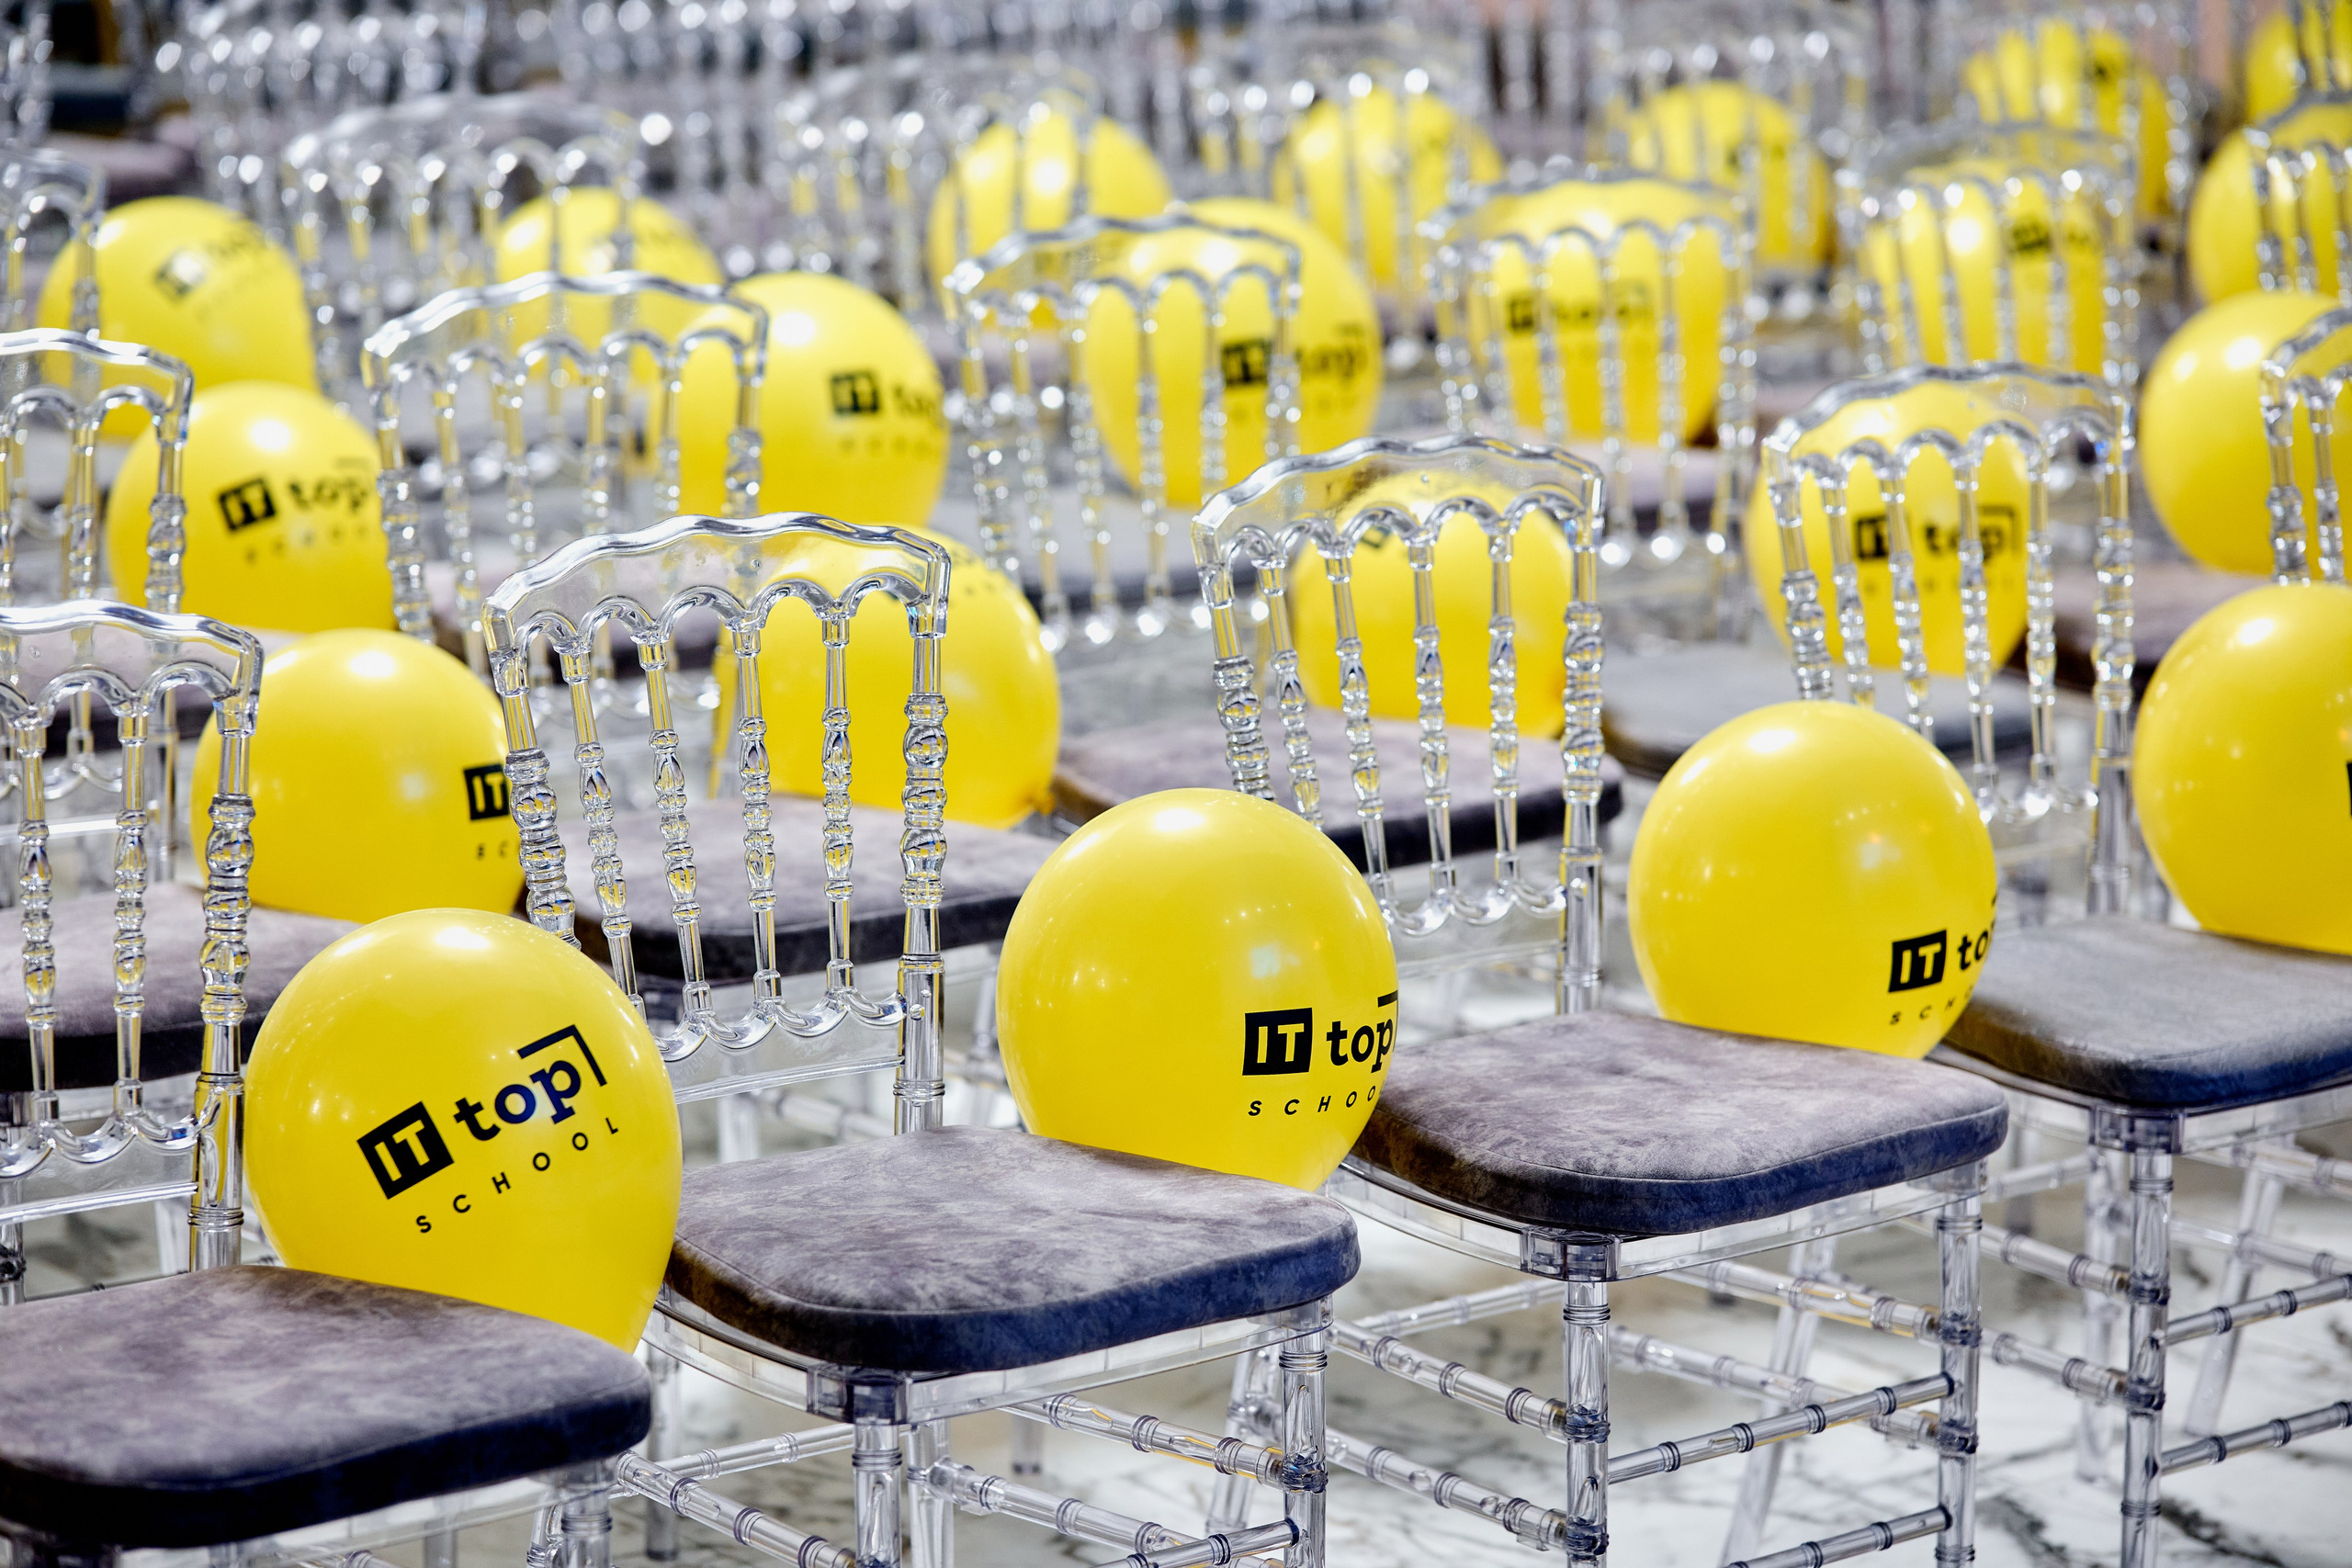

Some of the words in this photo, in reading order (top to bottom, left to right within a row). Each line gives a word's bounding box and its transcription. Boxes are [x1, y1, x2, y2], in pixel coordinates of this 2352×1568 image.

[1326, 1018, 1394, 1074] top
[452, 1060, 582, 1141] top
[1247, 1080, 1385, 1117] SCHOO
[415, 1116, 619, 1235] SCHOOL
